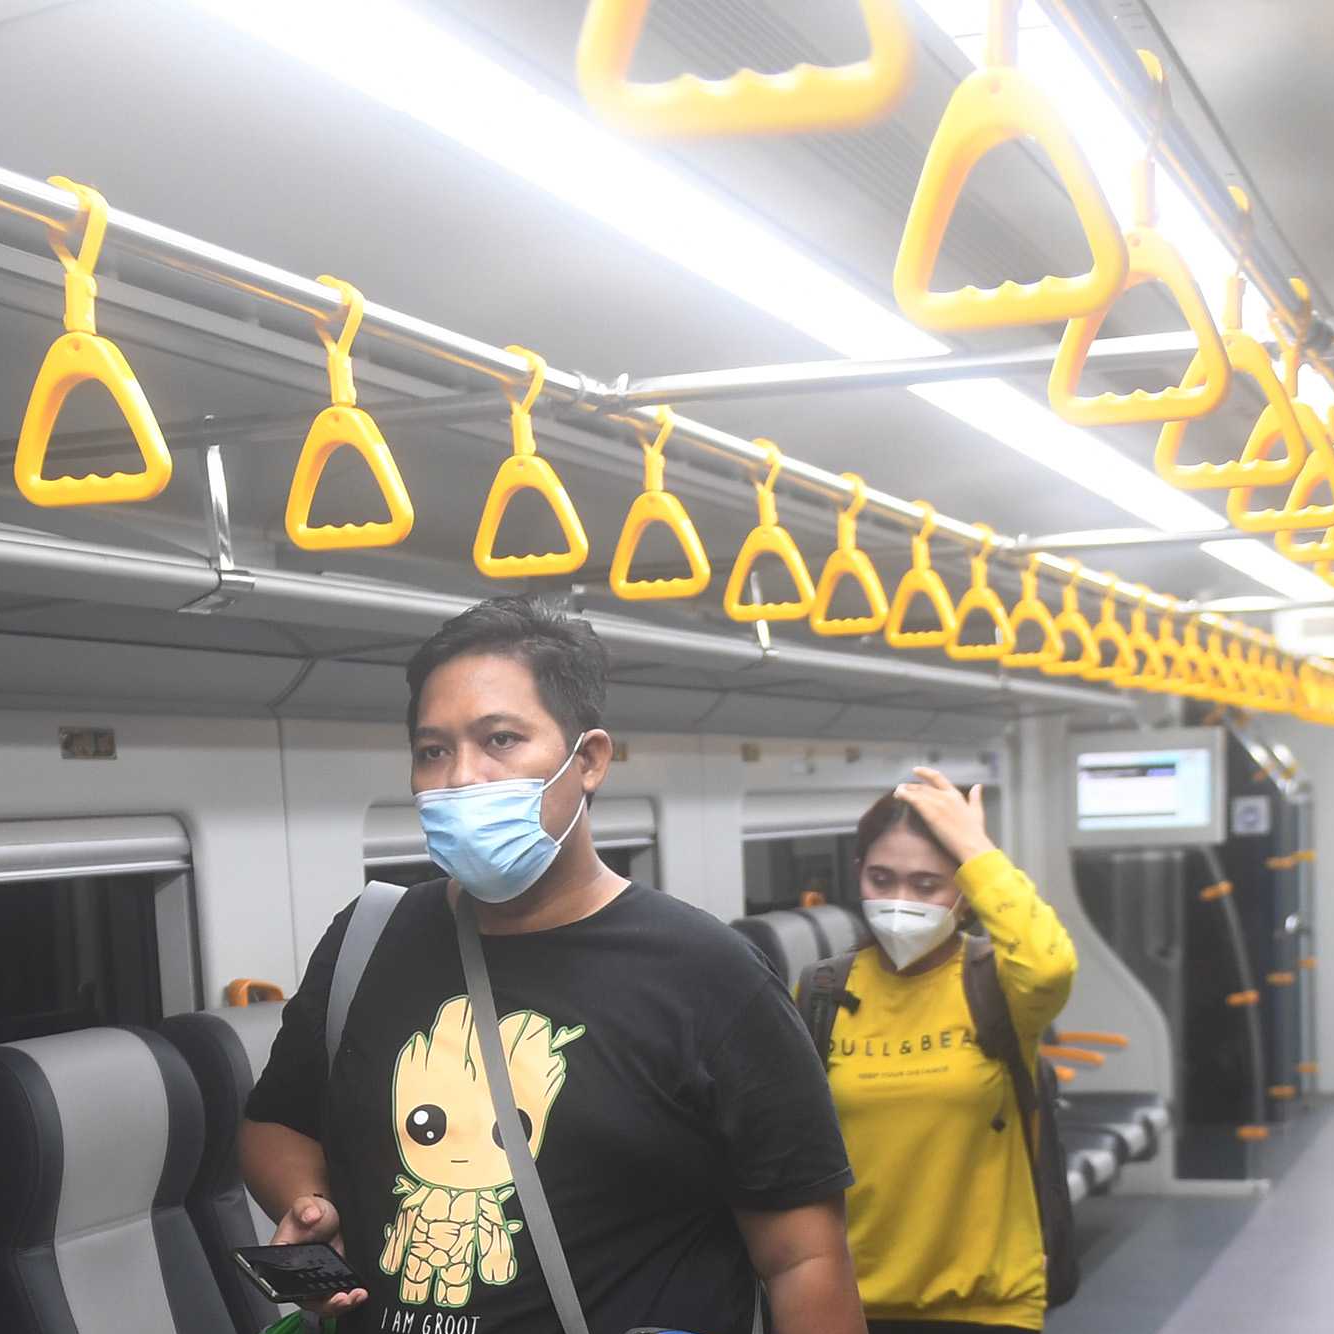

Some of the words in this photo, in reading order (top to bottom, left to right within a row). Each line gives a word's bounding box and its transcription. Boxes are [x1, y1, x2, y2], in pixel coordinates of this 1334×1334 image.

[828, 1030, 977, 1057] ULL&BEA
[381, 1307, 388, 1330] I
[391, 1310, 415, 1334] AM
